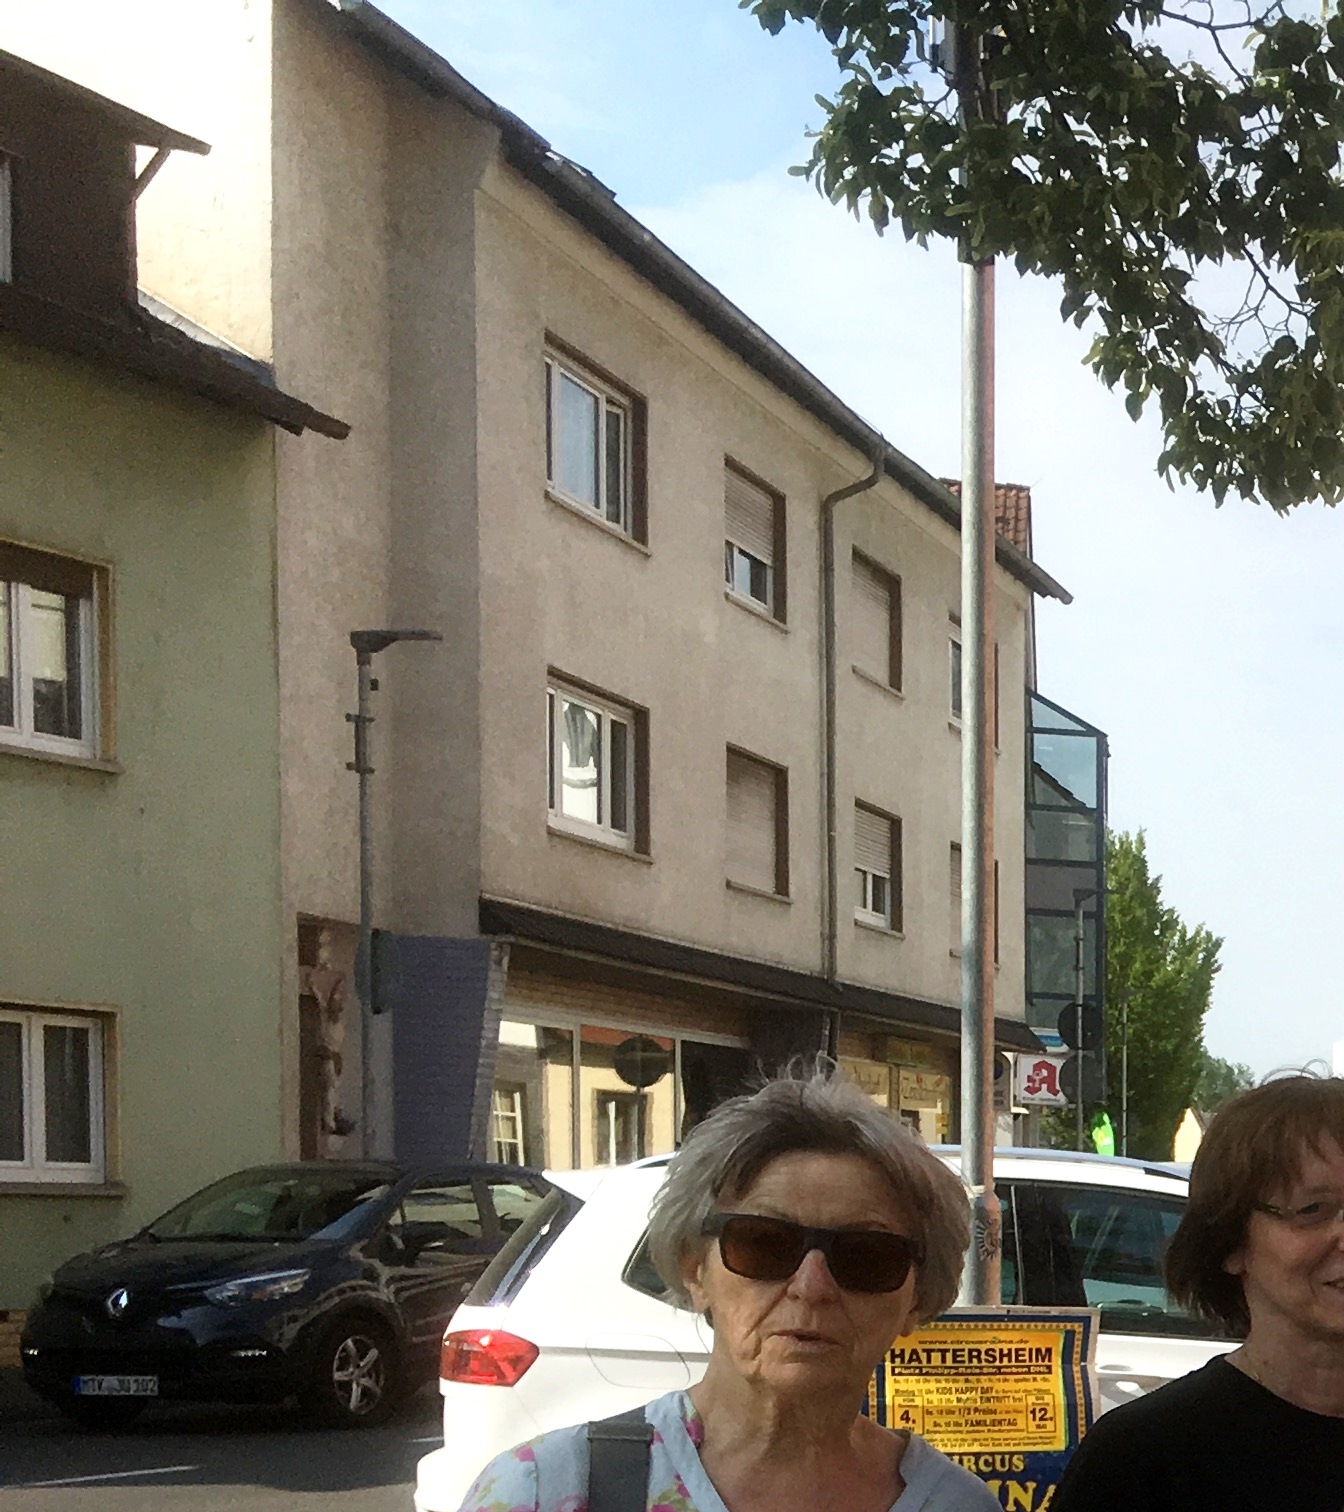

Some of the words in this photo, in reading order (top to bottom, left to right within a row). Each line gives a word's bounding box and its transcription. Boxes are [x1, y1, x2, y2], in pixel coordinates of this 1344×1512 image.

[890, 1347, 1053, 1364] HATTERSHEIM
[899, 1409, 917, 1425] 4.
[1029, 1407, 1054, 1422] 12.
[951, 1454, 1025, 1473] IRCUS
